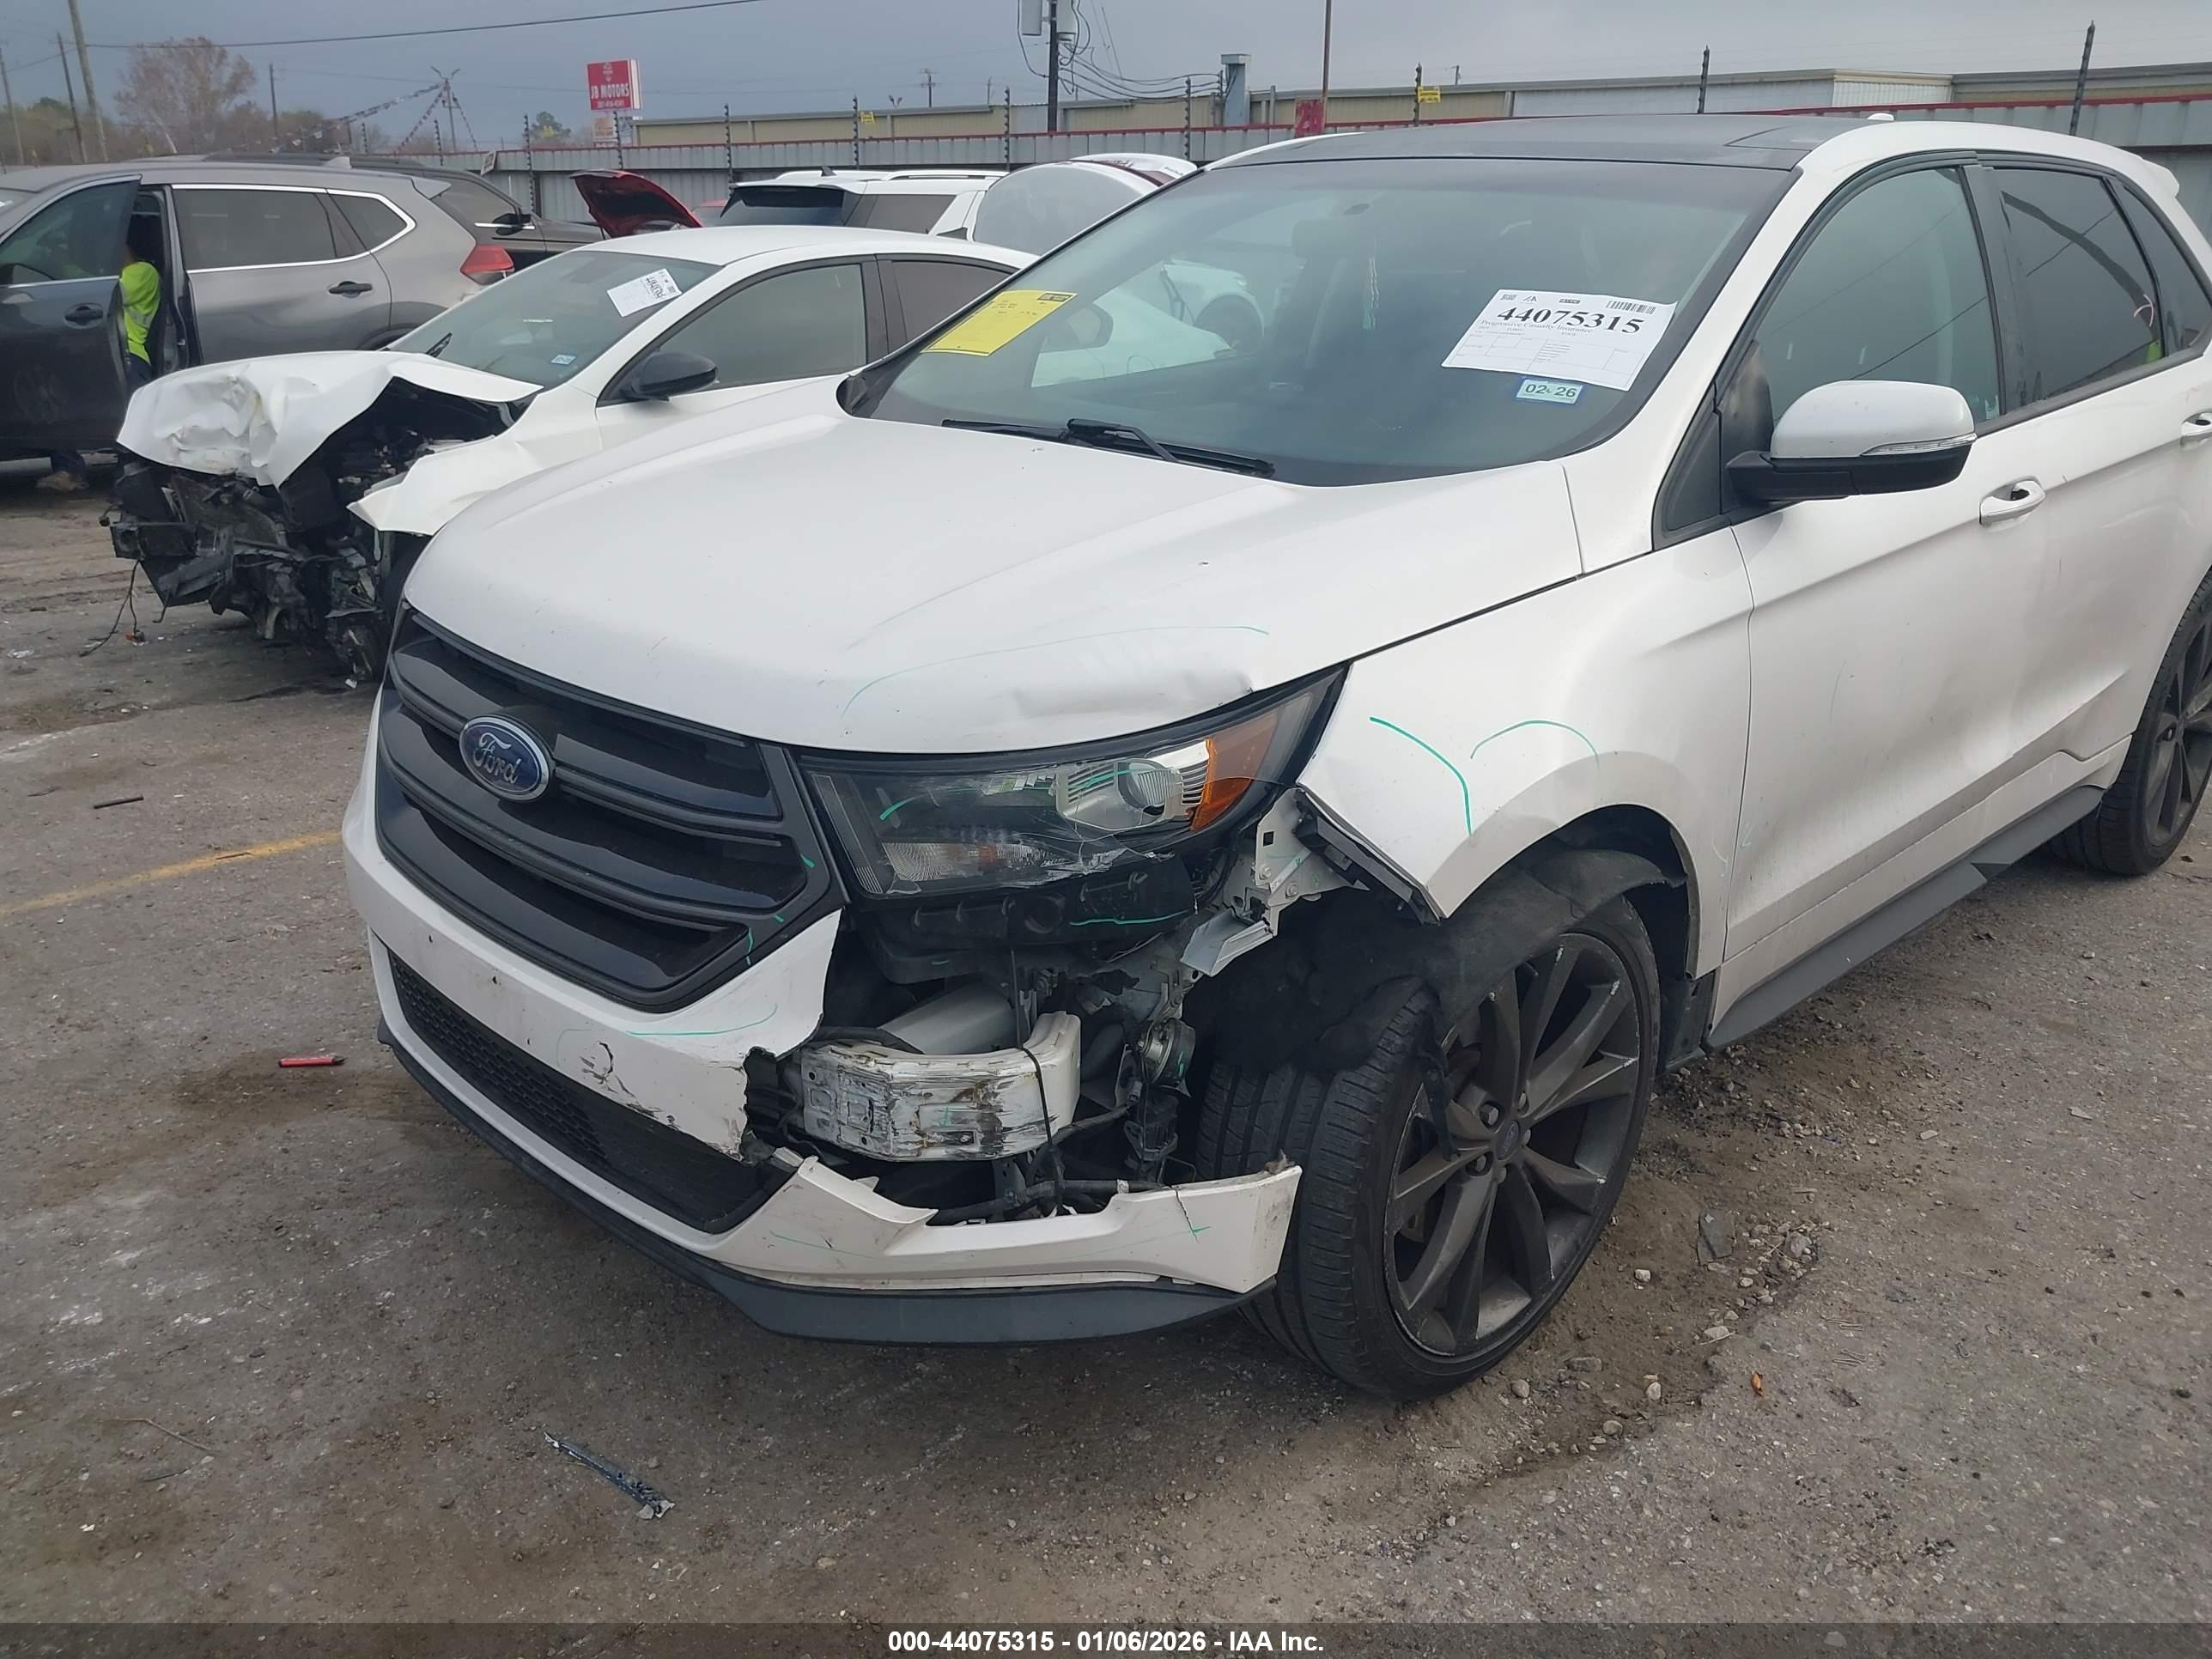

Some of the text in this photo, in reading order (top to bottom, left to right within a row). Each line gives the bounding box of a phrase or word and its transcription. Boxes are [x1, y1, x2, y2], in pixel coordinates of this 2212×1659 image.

[601, 82, 629, 99] MOTORS
[1480, 319, 1523, 329] Progressive
[1523, 322, 1554, 331] Casualty
[1557, 325, 1594, 334] Insurance
[1497, 307, 1644, 334] 44075315
[1525, 384, 1577, 398] 02 26
[472, 732, 523, 785] Ford
